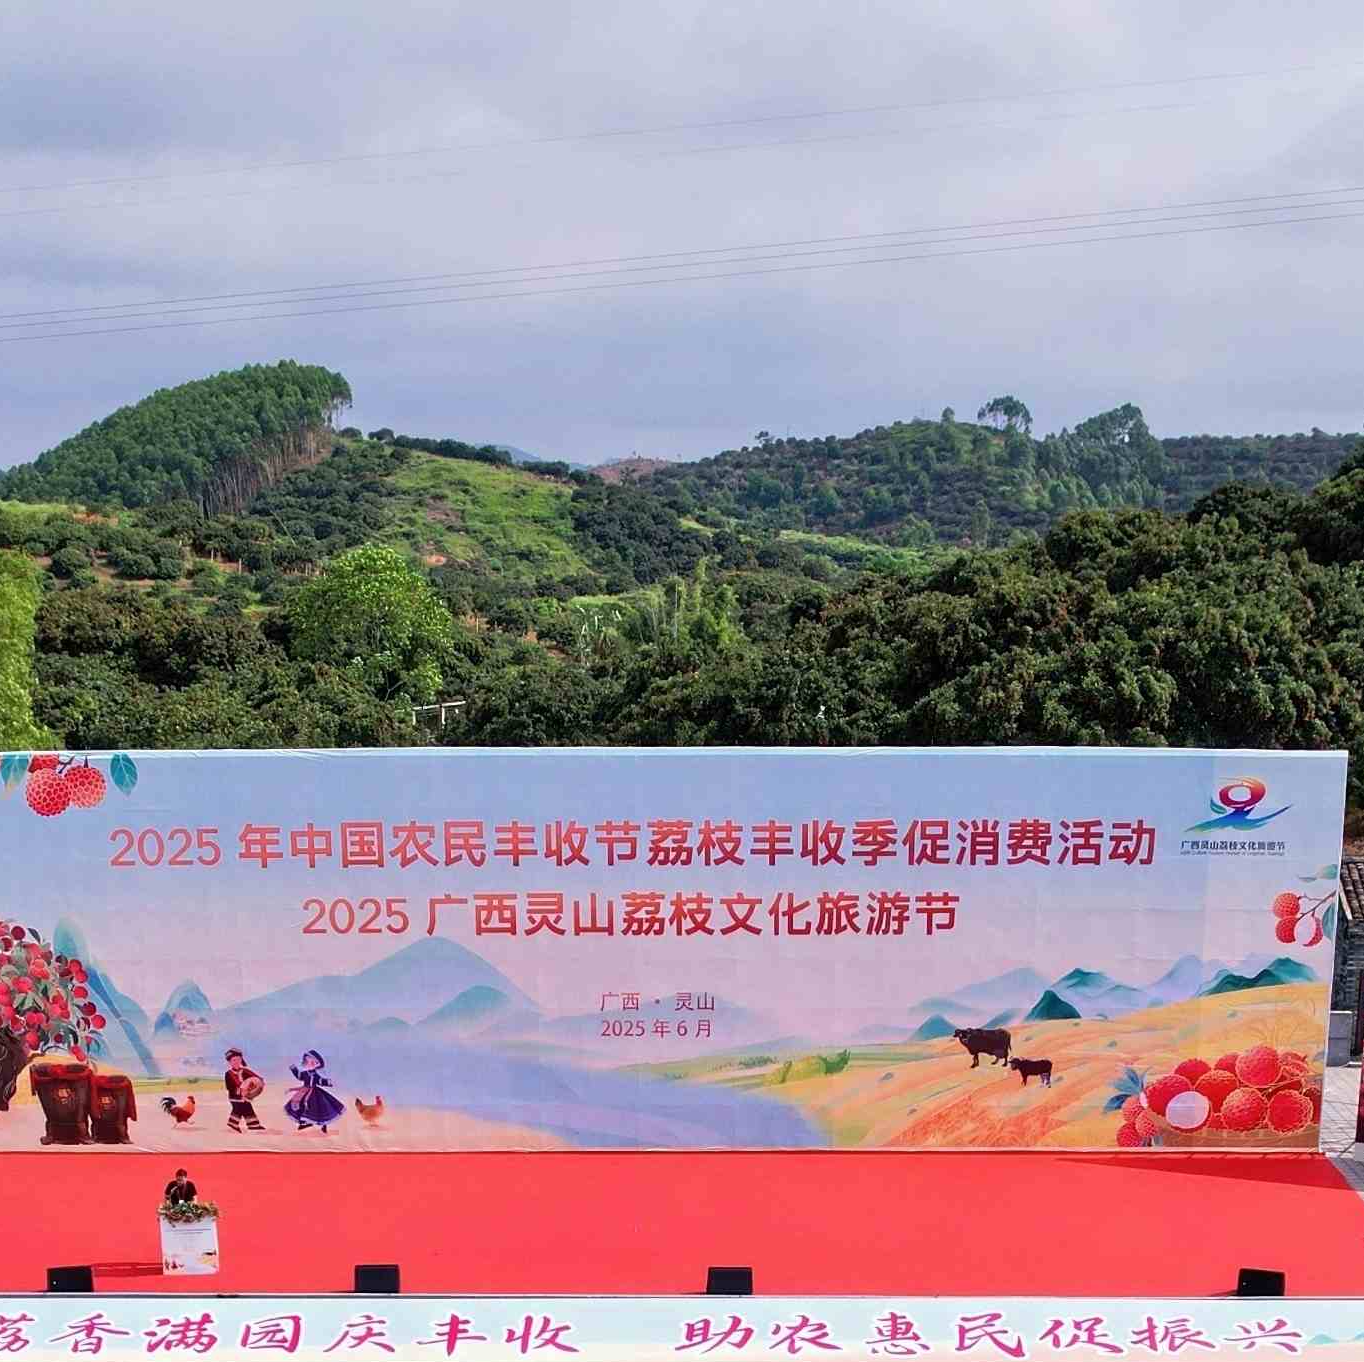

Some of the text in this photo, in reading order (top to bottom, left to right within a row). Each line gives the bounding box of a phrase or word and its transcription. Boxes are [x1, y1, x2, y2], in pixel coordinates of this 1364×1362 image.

[109, 817, 1157, 870] 2025 年中国农民丰收节荔枝丰收季促消费活动
[302, 889, 961, 938] 2025 广西灵山荔枝文化旅游节
[600, 992, 641, 1012] 广西
[674, 992, 715, 1012] 灵山
[601, 1020, 646, 1037] 2025
